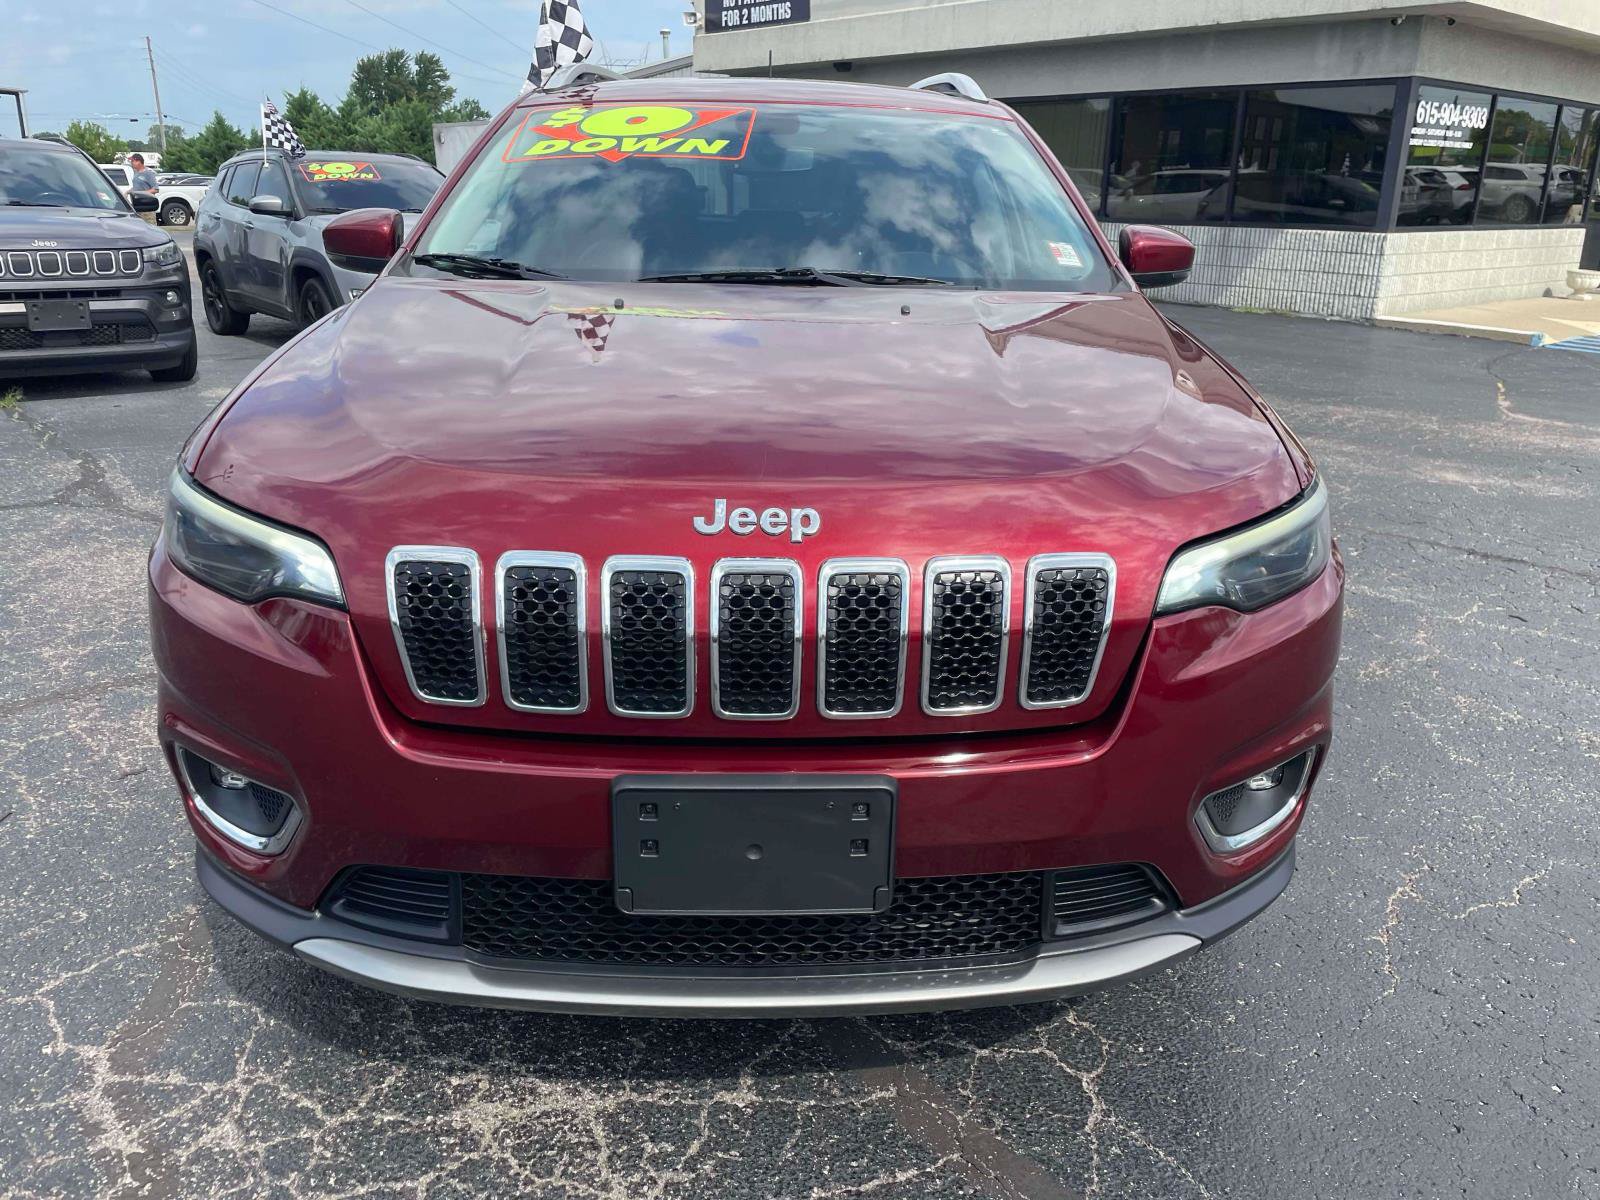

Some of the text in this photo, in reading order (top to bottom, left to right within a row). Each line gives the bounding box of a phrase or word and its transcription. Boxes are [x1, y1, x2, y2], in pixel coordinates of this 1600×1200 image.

[721, 10, 740, 27] FOR
[742, 8, 749, 25] 2
[751, 2, 792, 23] MONTHS
[542, 105, 693, 136] $0
[1416, 100, 1488, 129] 615-904-9303
[524, 137, 731, 156] DOWN
[313, 172, 374, 181] DOWN
[31, 239, 58, 248] Jeep
[692, 498, 821, 544] Jeep
